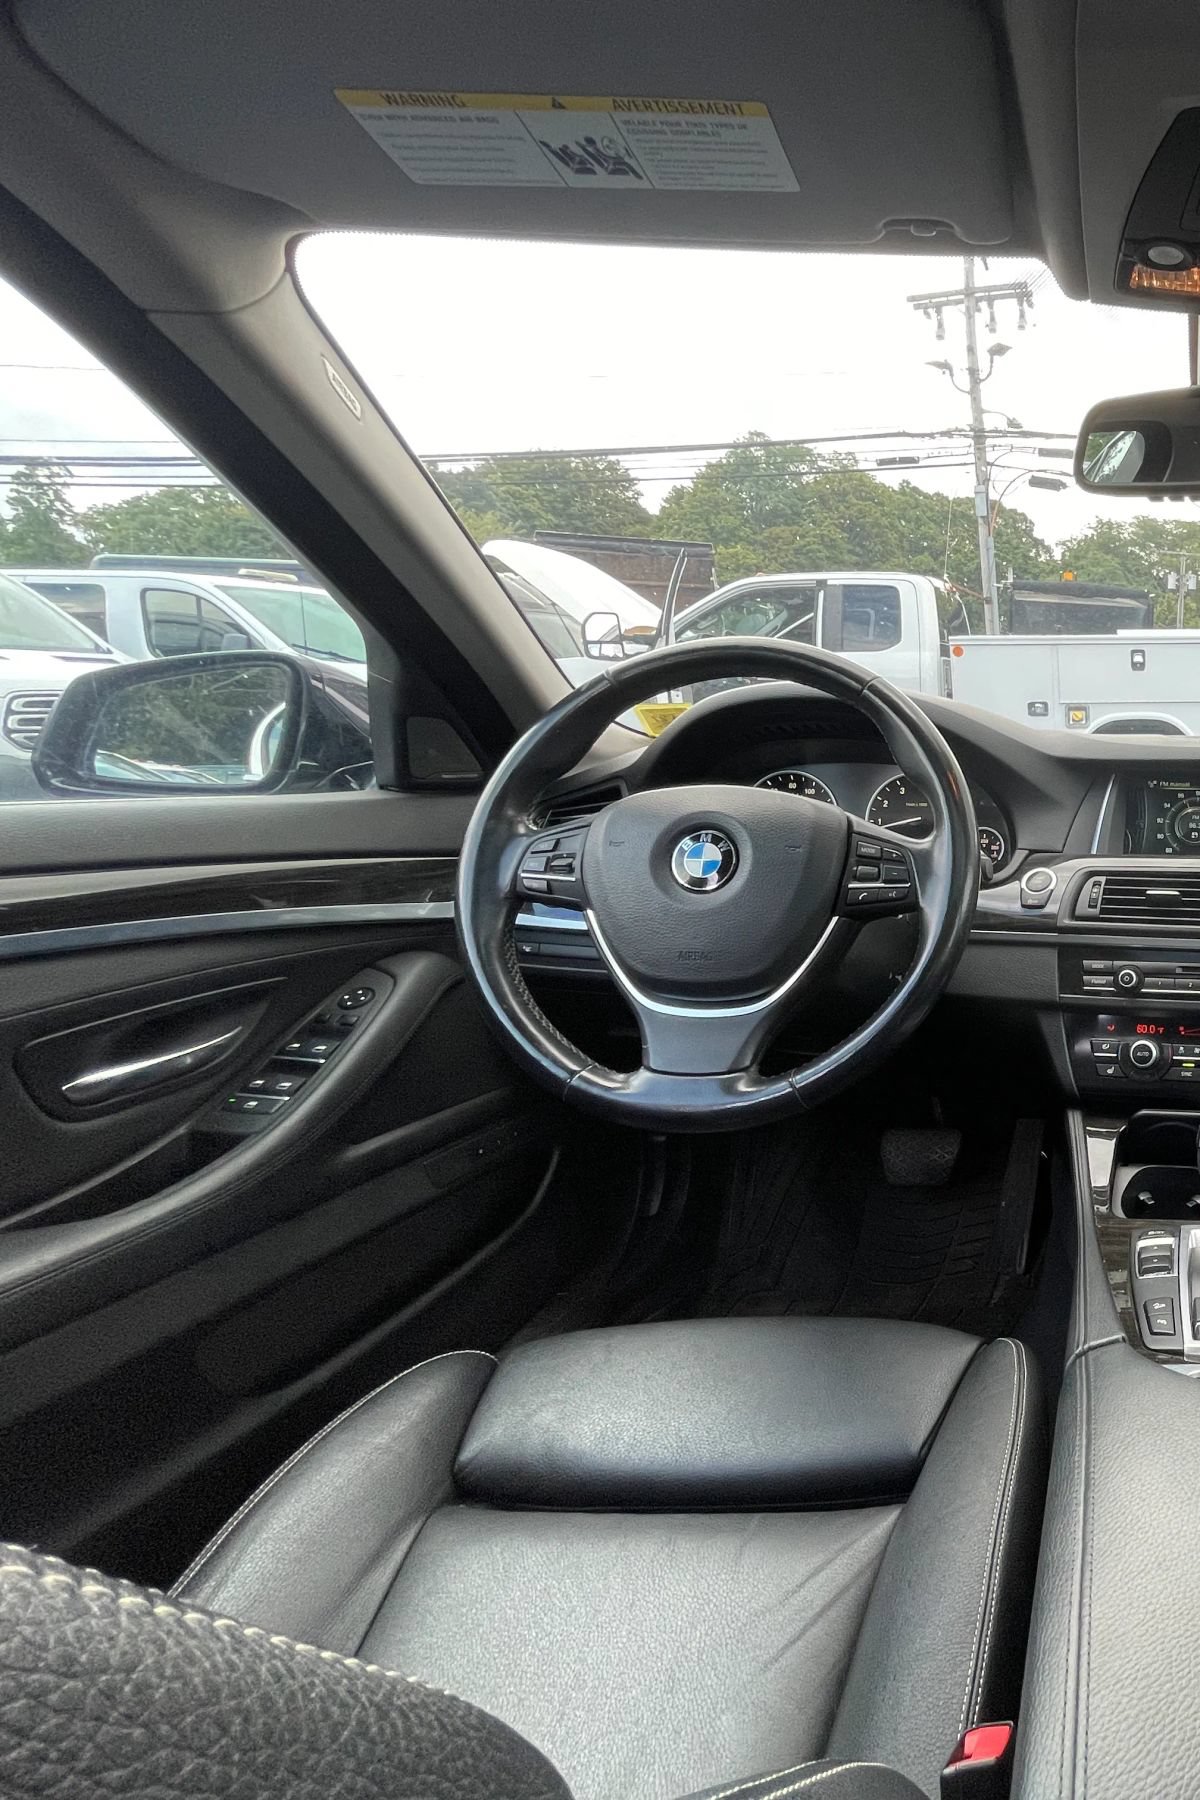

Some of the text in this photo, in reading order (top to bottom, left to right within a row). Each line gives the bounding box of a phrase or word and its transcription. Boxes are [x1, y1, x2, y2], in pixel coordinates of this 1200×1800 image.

[379, 93, 467, 108] WARNING
[611, 98, 744, 115] AVERTISSEMENT
[899, 787, 906, 795] 3
[883, 800, 888, 808] 2
[681, 833, 731, 852] BMW
[1136, 1024, 1155, 1034] 60.0
